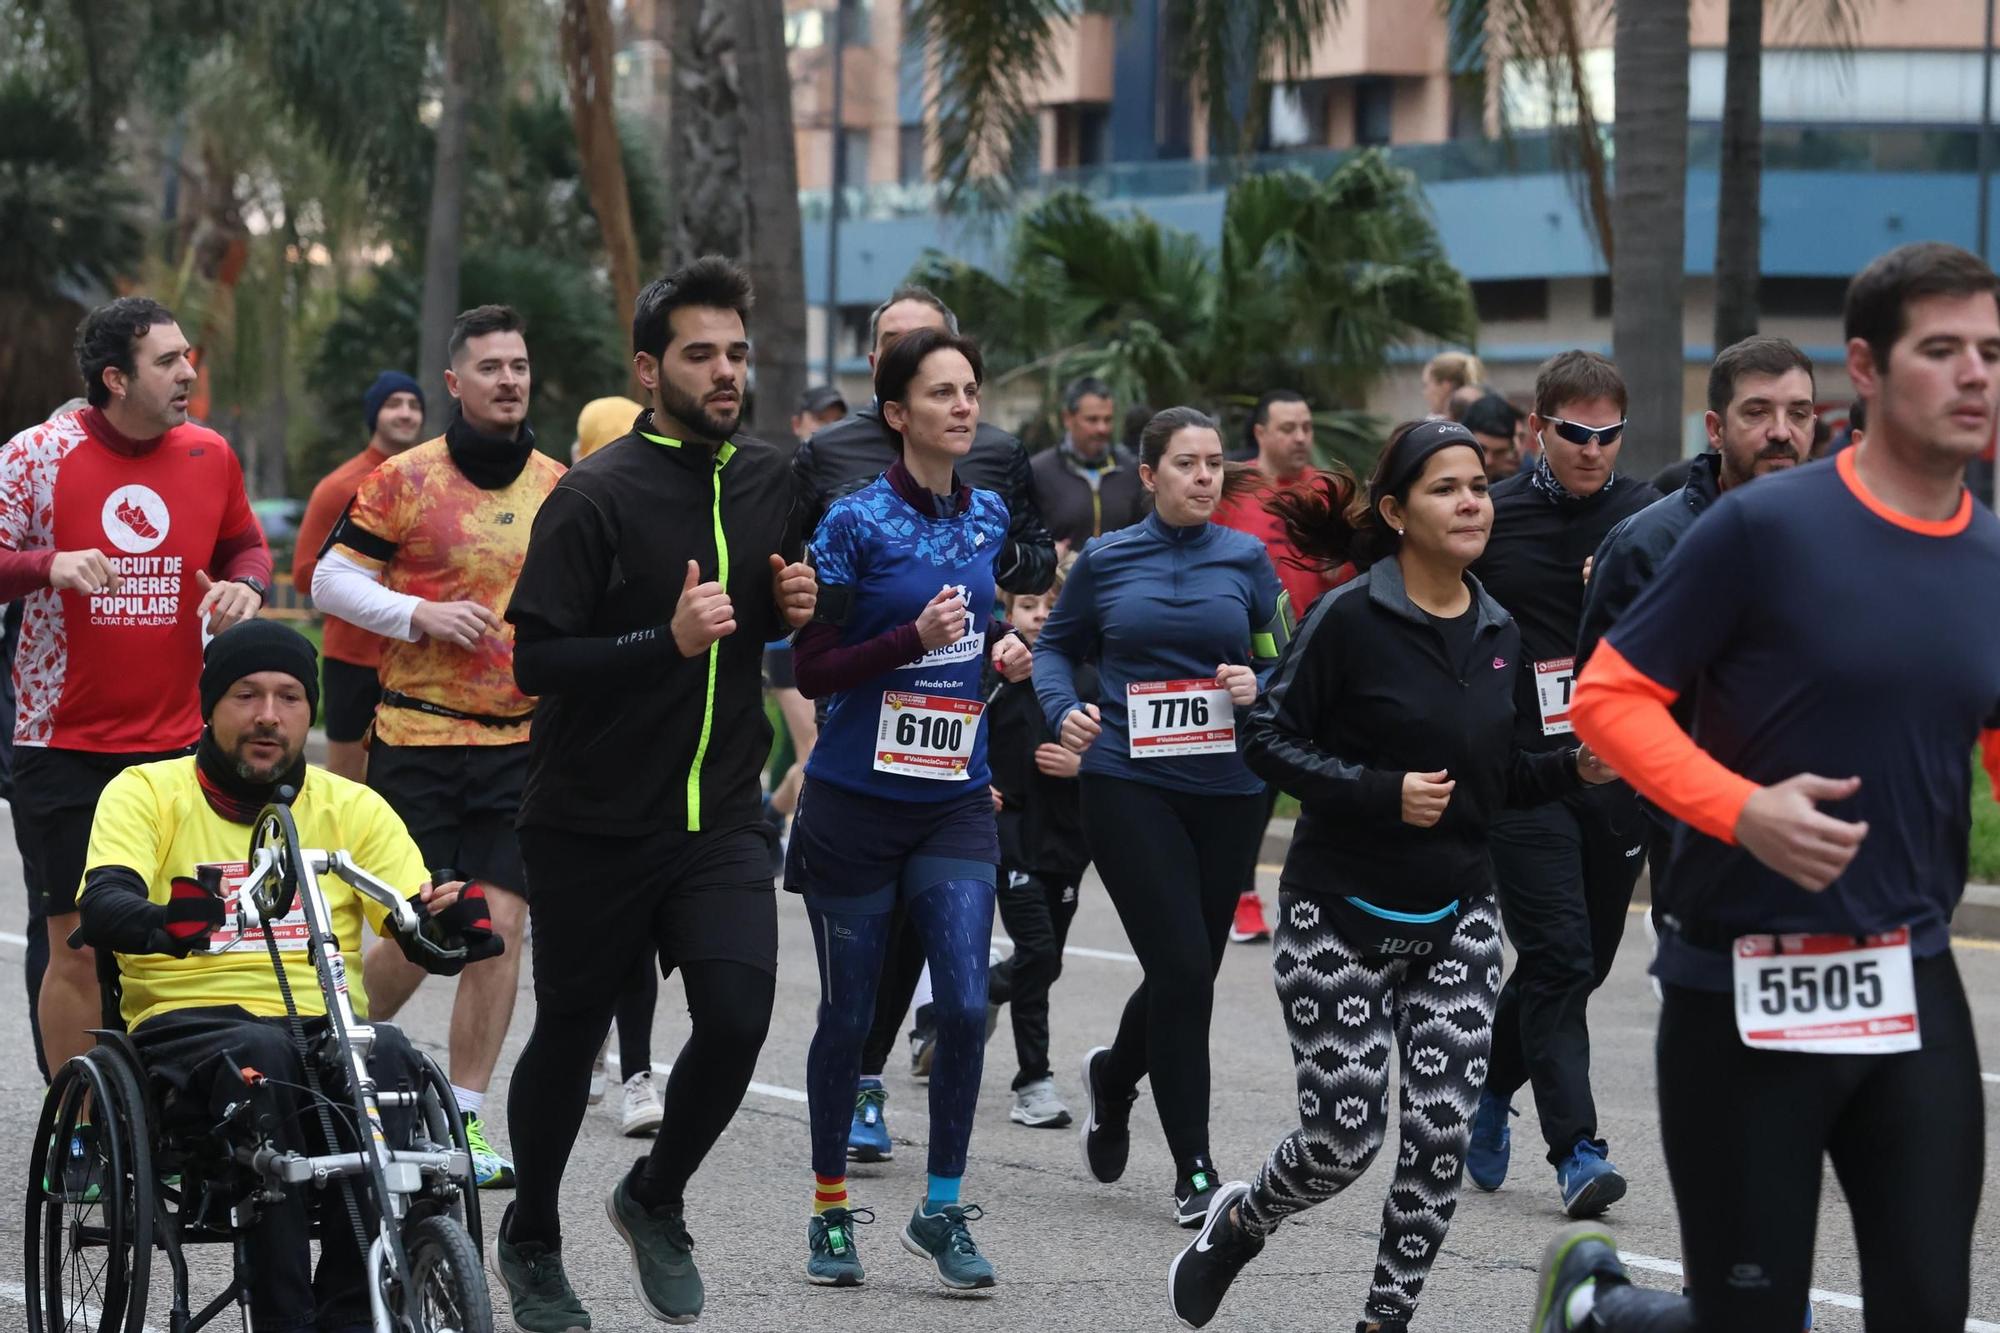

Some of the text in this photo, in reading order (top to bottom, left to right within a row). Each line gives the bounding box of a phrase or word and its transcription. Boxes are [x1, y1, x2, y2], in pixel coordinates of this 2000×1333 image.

[106, 556, 183, 575] RCUIT DE
[92, 576, 181, 595] RRERES
[90, 596, 179, 616] POPULARS
[90, 616, 122, 625] CIUTAT
[123, 617, 136, 626] DE
[1148, 697, 1209, 729] 7776
[895, 713, 963, 752] 6100
[1760, 961, 1882, 1015] 5505
